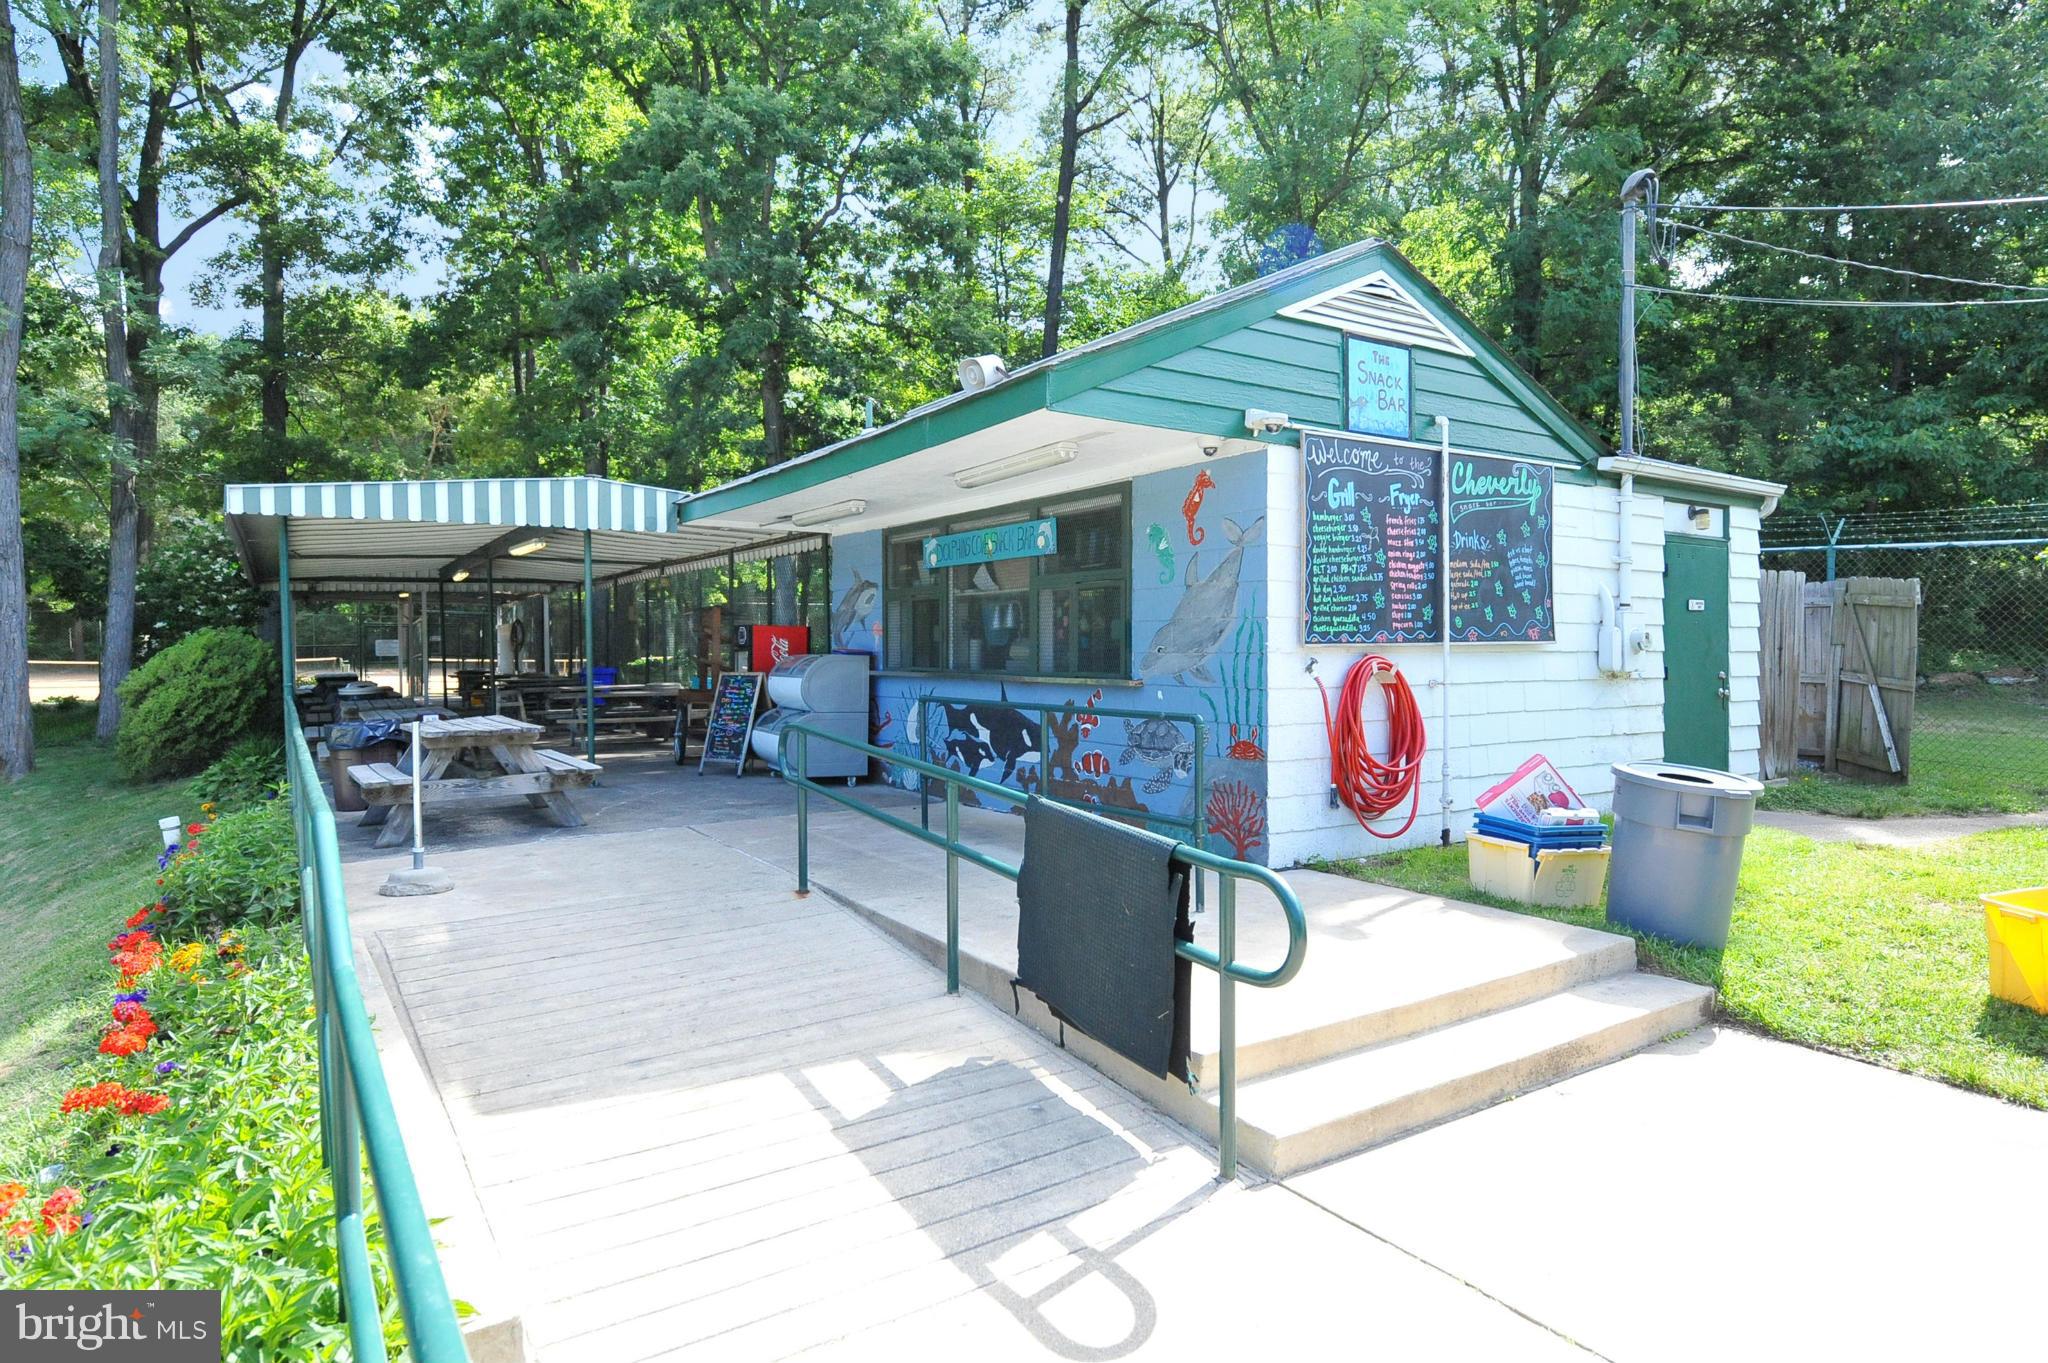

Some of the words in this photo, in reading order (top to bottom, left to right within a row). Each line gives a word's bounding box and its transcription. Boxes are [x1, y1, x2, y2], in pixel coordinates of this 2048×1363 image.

[1372, 351, 1390, 366] THE
[1357, 360, 1404, 391] SNACK
[1377, 389, 1408, 414] BAR
[1307, 439, 1383, 471] Welcome
[1394, 451, 1404, 466] to
[1410, 456, 1425, 471] the
[1328, 477, 1355, 509] Grill
[1389, 483, 1420, 514] Fryer
[1452, 461, 1542, 516] Cheverly
[1312, 510, 1342, 525] hamburger
[1312, 522, 1346, 535] cheeseburger
[1452, 529, 1489, 551] Drinks
[1312, 564, 1326, 575] BLT
[1313, 584, 1321, 593] hot
[1322, 584, 1333, 596] dog
[1313, 594, 1321, 603] hot
[1322, 594, 1332, 605] dog
